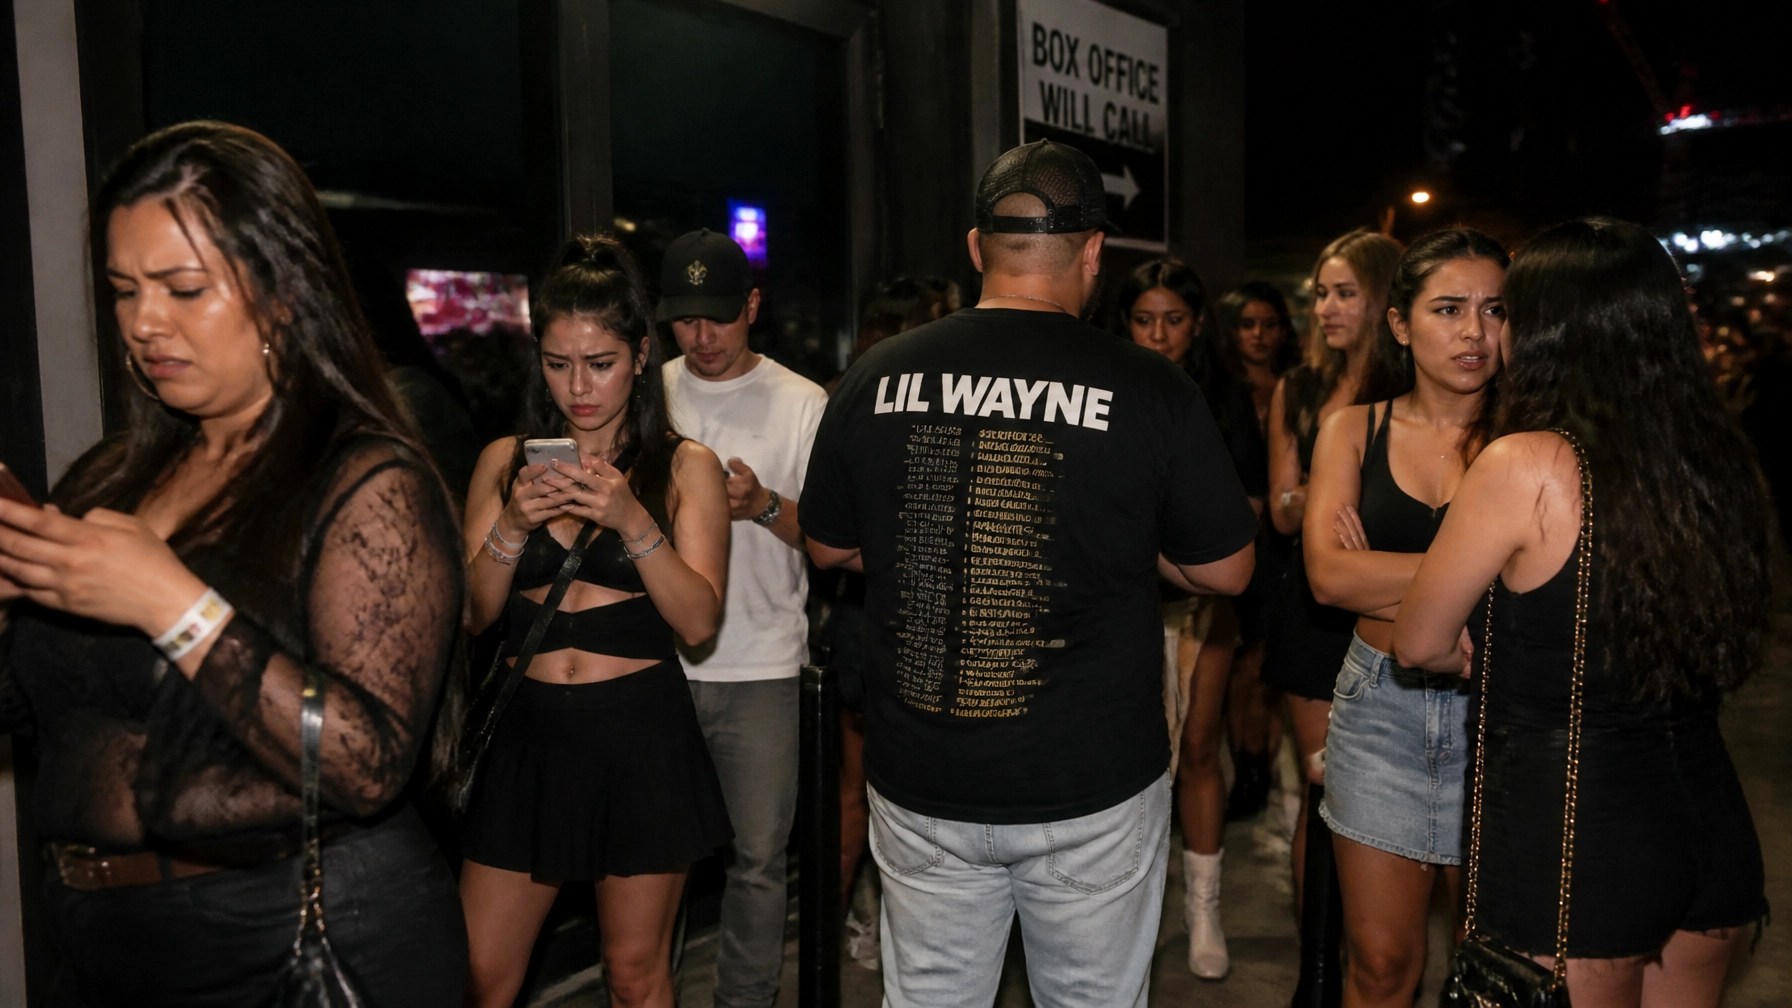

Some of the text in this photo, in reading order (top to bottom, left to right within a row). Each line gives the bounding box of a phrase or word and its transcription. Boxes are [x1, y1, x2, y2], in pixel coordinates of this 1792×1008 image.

[1033, 23, 1159, 104] BOX OFFICE
[1040, 80, 1153, 149] WILL CALL
[874, 372, 1114, 431] LIL WAYNE
